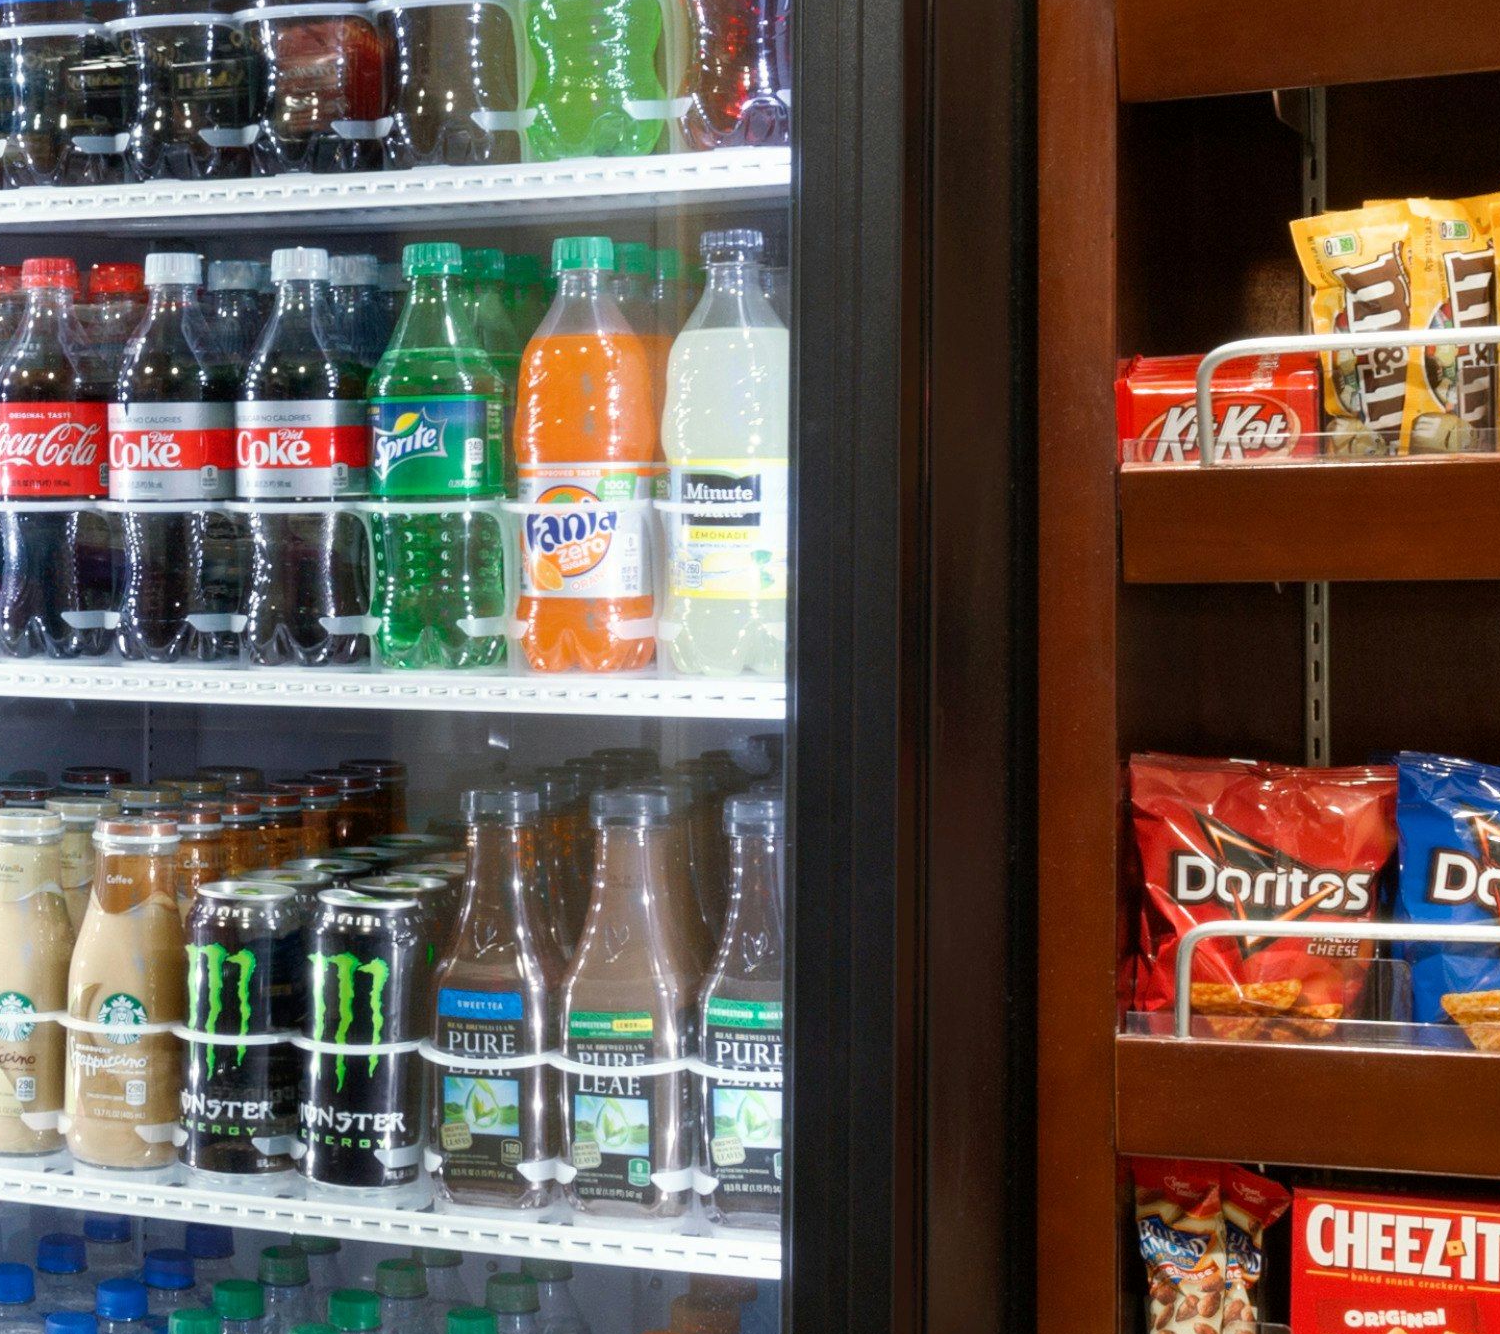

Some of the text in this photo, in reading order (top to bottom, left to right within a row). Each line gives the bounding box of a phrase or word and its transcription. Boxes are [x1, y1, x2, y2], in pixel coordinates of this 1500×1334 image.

[109, 434, 183, 468] Coke
[237, 431, 313, 466] Coke
[375, 421, 439, 463] Sprite
[685, 483, 753, 502] Minute
[689, 531, 749, 540] LEMONADE
[556, 539, 607, 561] zero
[106, 874, 133, 885] Coffee
[1176, 854, 1371, 910] Doritos
[1307, 942, 1358, 957] CHEESE
[448, 1031, 515, 1054] PURE
[1351, 1272, 1465, 1292] baked snack crackers
